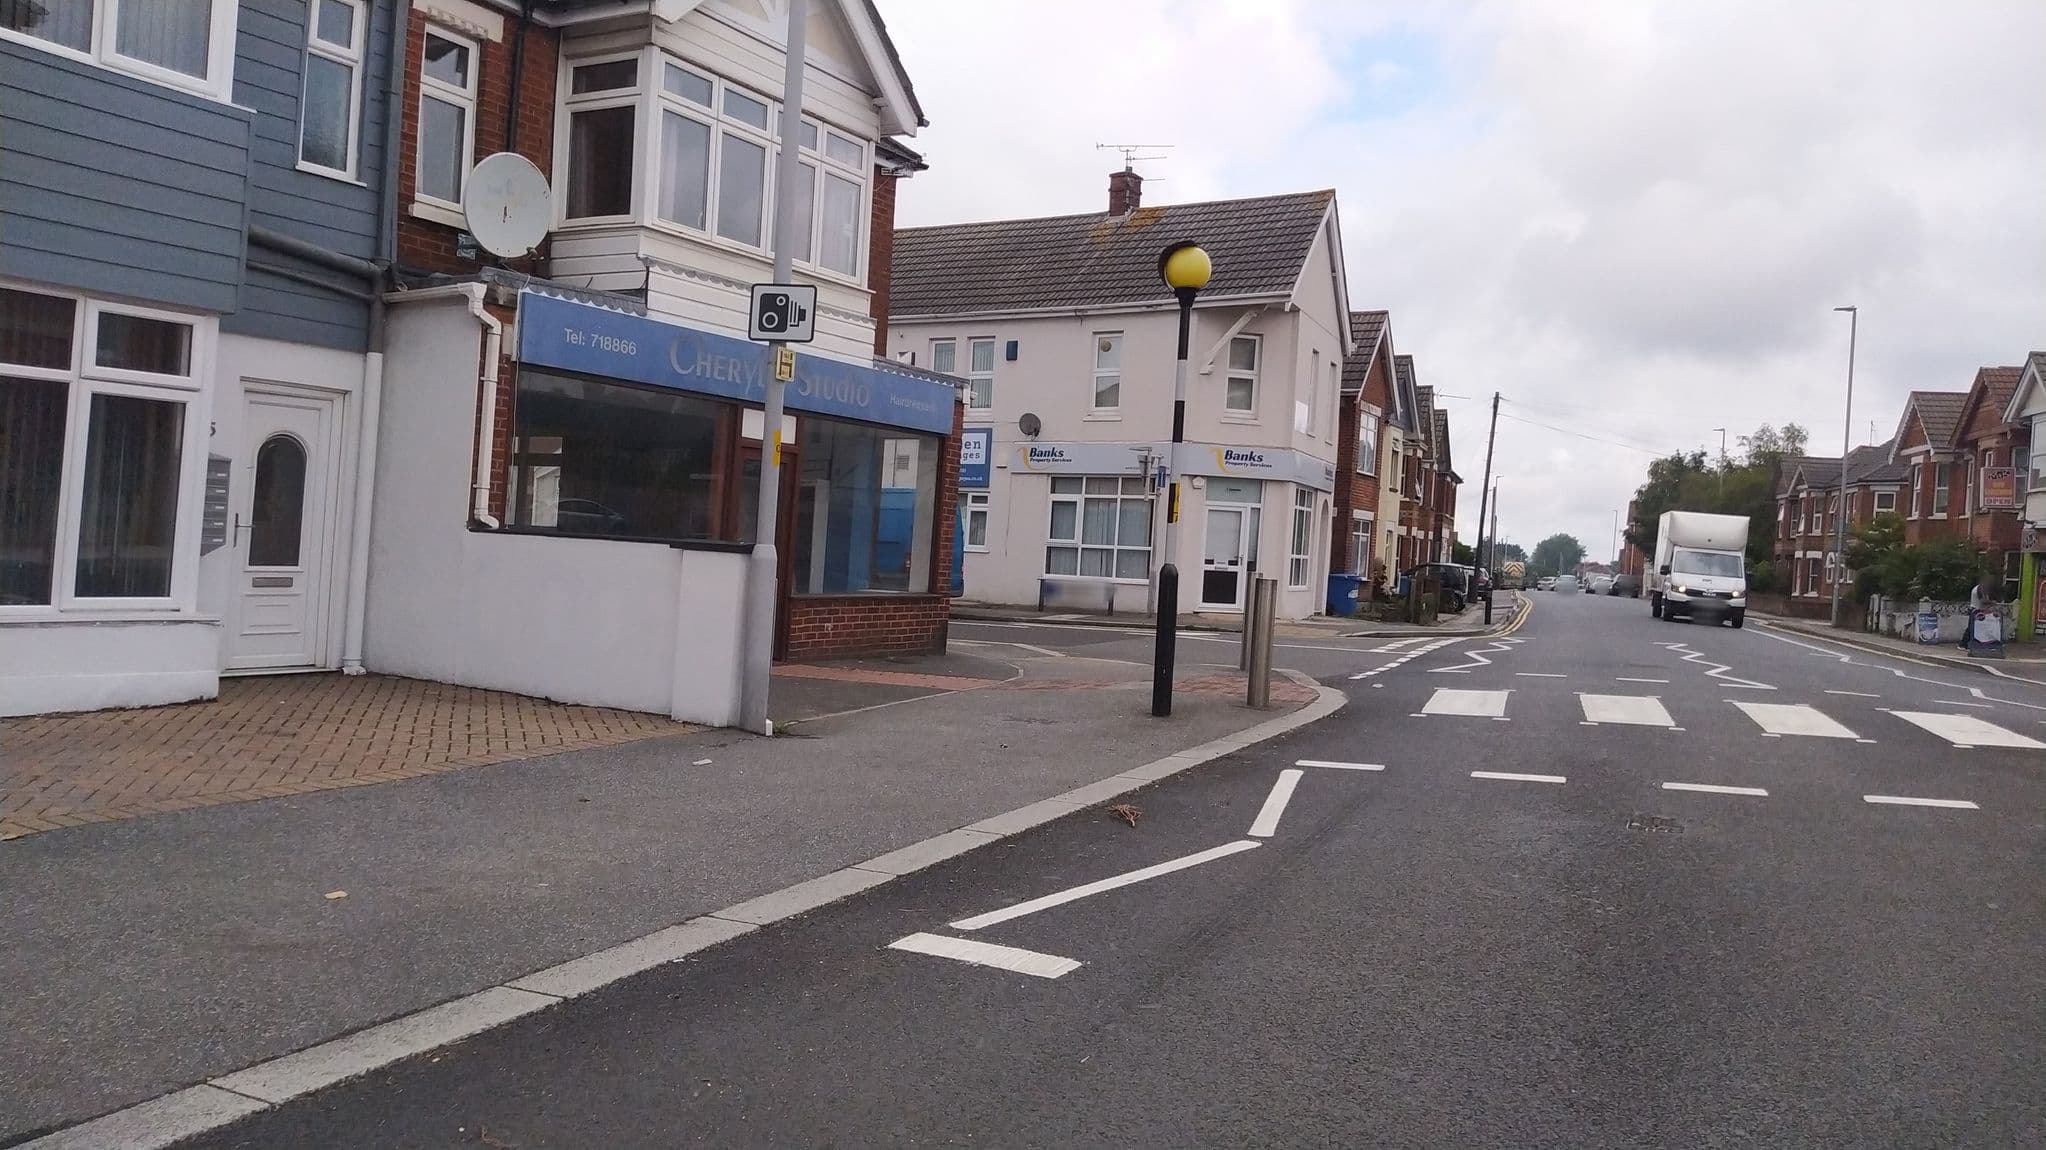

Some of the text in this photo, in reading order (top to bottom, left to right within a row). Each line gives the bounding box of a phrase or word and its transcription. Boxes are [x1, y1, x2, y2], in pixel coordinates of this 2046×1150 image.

[564, 328, 637, 355] Tel: 718866
[964, 440, 981, 450] en
[962, 452, 981, 461] ges
[1030, 447, 1065, 458] Banks
[1225, 450, 1264, 462] Banks
